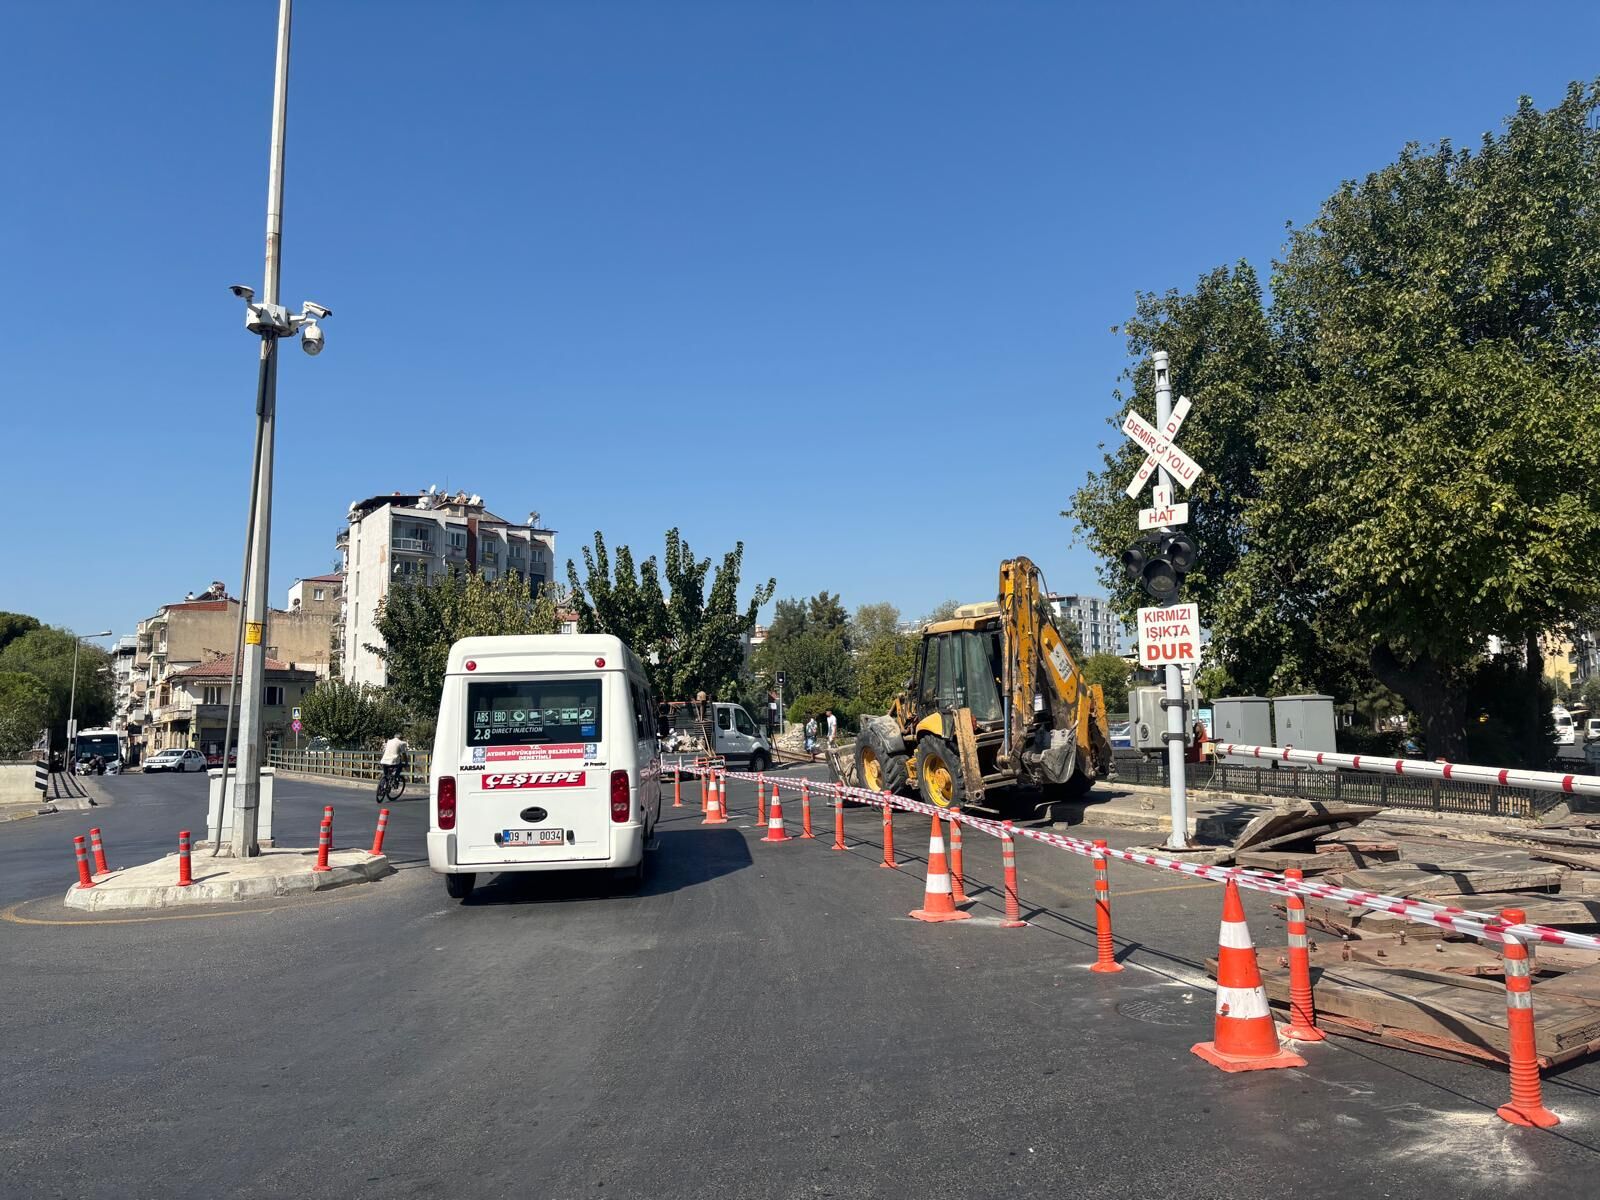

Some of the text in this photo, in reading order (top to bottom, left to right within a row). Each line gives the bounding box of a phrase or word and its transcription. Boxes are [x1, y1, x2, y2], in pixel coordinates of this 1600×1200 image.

[1127, 418, 1194, 480] DEMİR YOLU
[1158, 491, 1164, 503] 1
[1149, 510, 1175, 523] HAT
[1144, 608, 1191, 623] KIRMIZI
[1146, 624, 1190, 642] IŞIKTA
[1147, 643, 1194, 660] DUR
[477, 712, 489, 722] ABS
[494, 712, 506, 722] EBD
[474, 728, 491, 740] 2.8
[513, 726, 543, 734] INJECTION
[485, 771, 582, 789] ÇEŞTEPE
[510, 831, 561, 841] 09 M 0034
